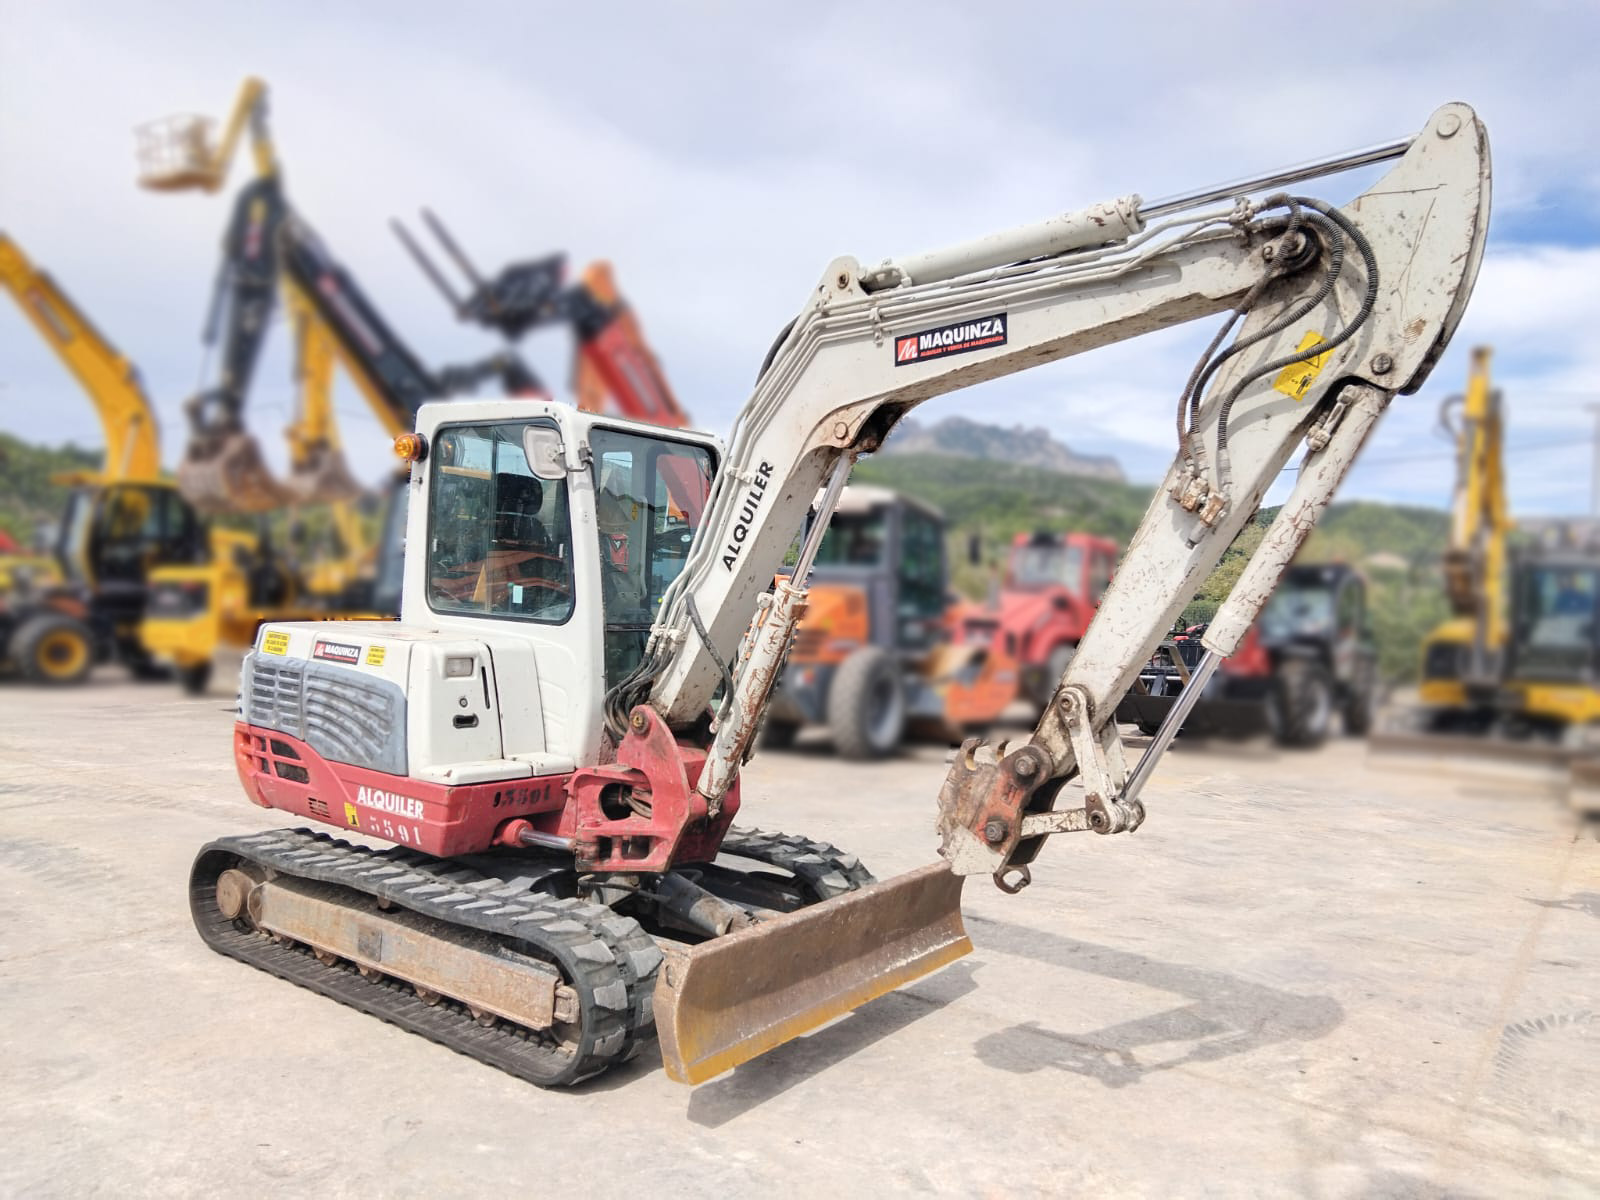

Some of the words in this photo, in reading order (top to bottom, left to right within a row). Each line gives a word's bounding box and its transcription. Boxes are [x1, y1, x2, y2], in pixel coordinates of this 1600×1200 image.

[920, 319, 1004, 350] MAQUINZA
[723, 462, 774, 572] ALQUILER
[325, 644, 359, 658] MAQUINZA
[357, 785, 424, 820] ALQUILER
